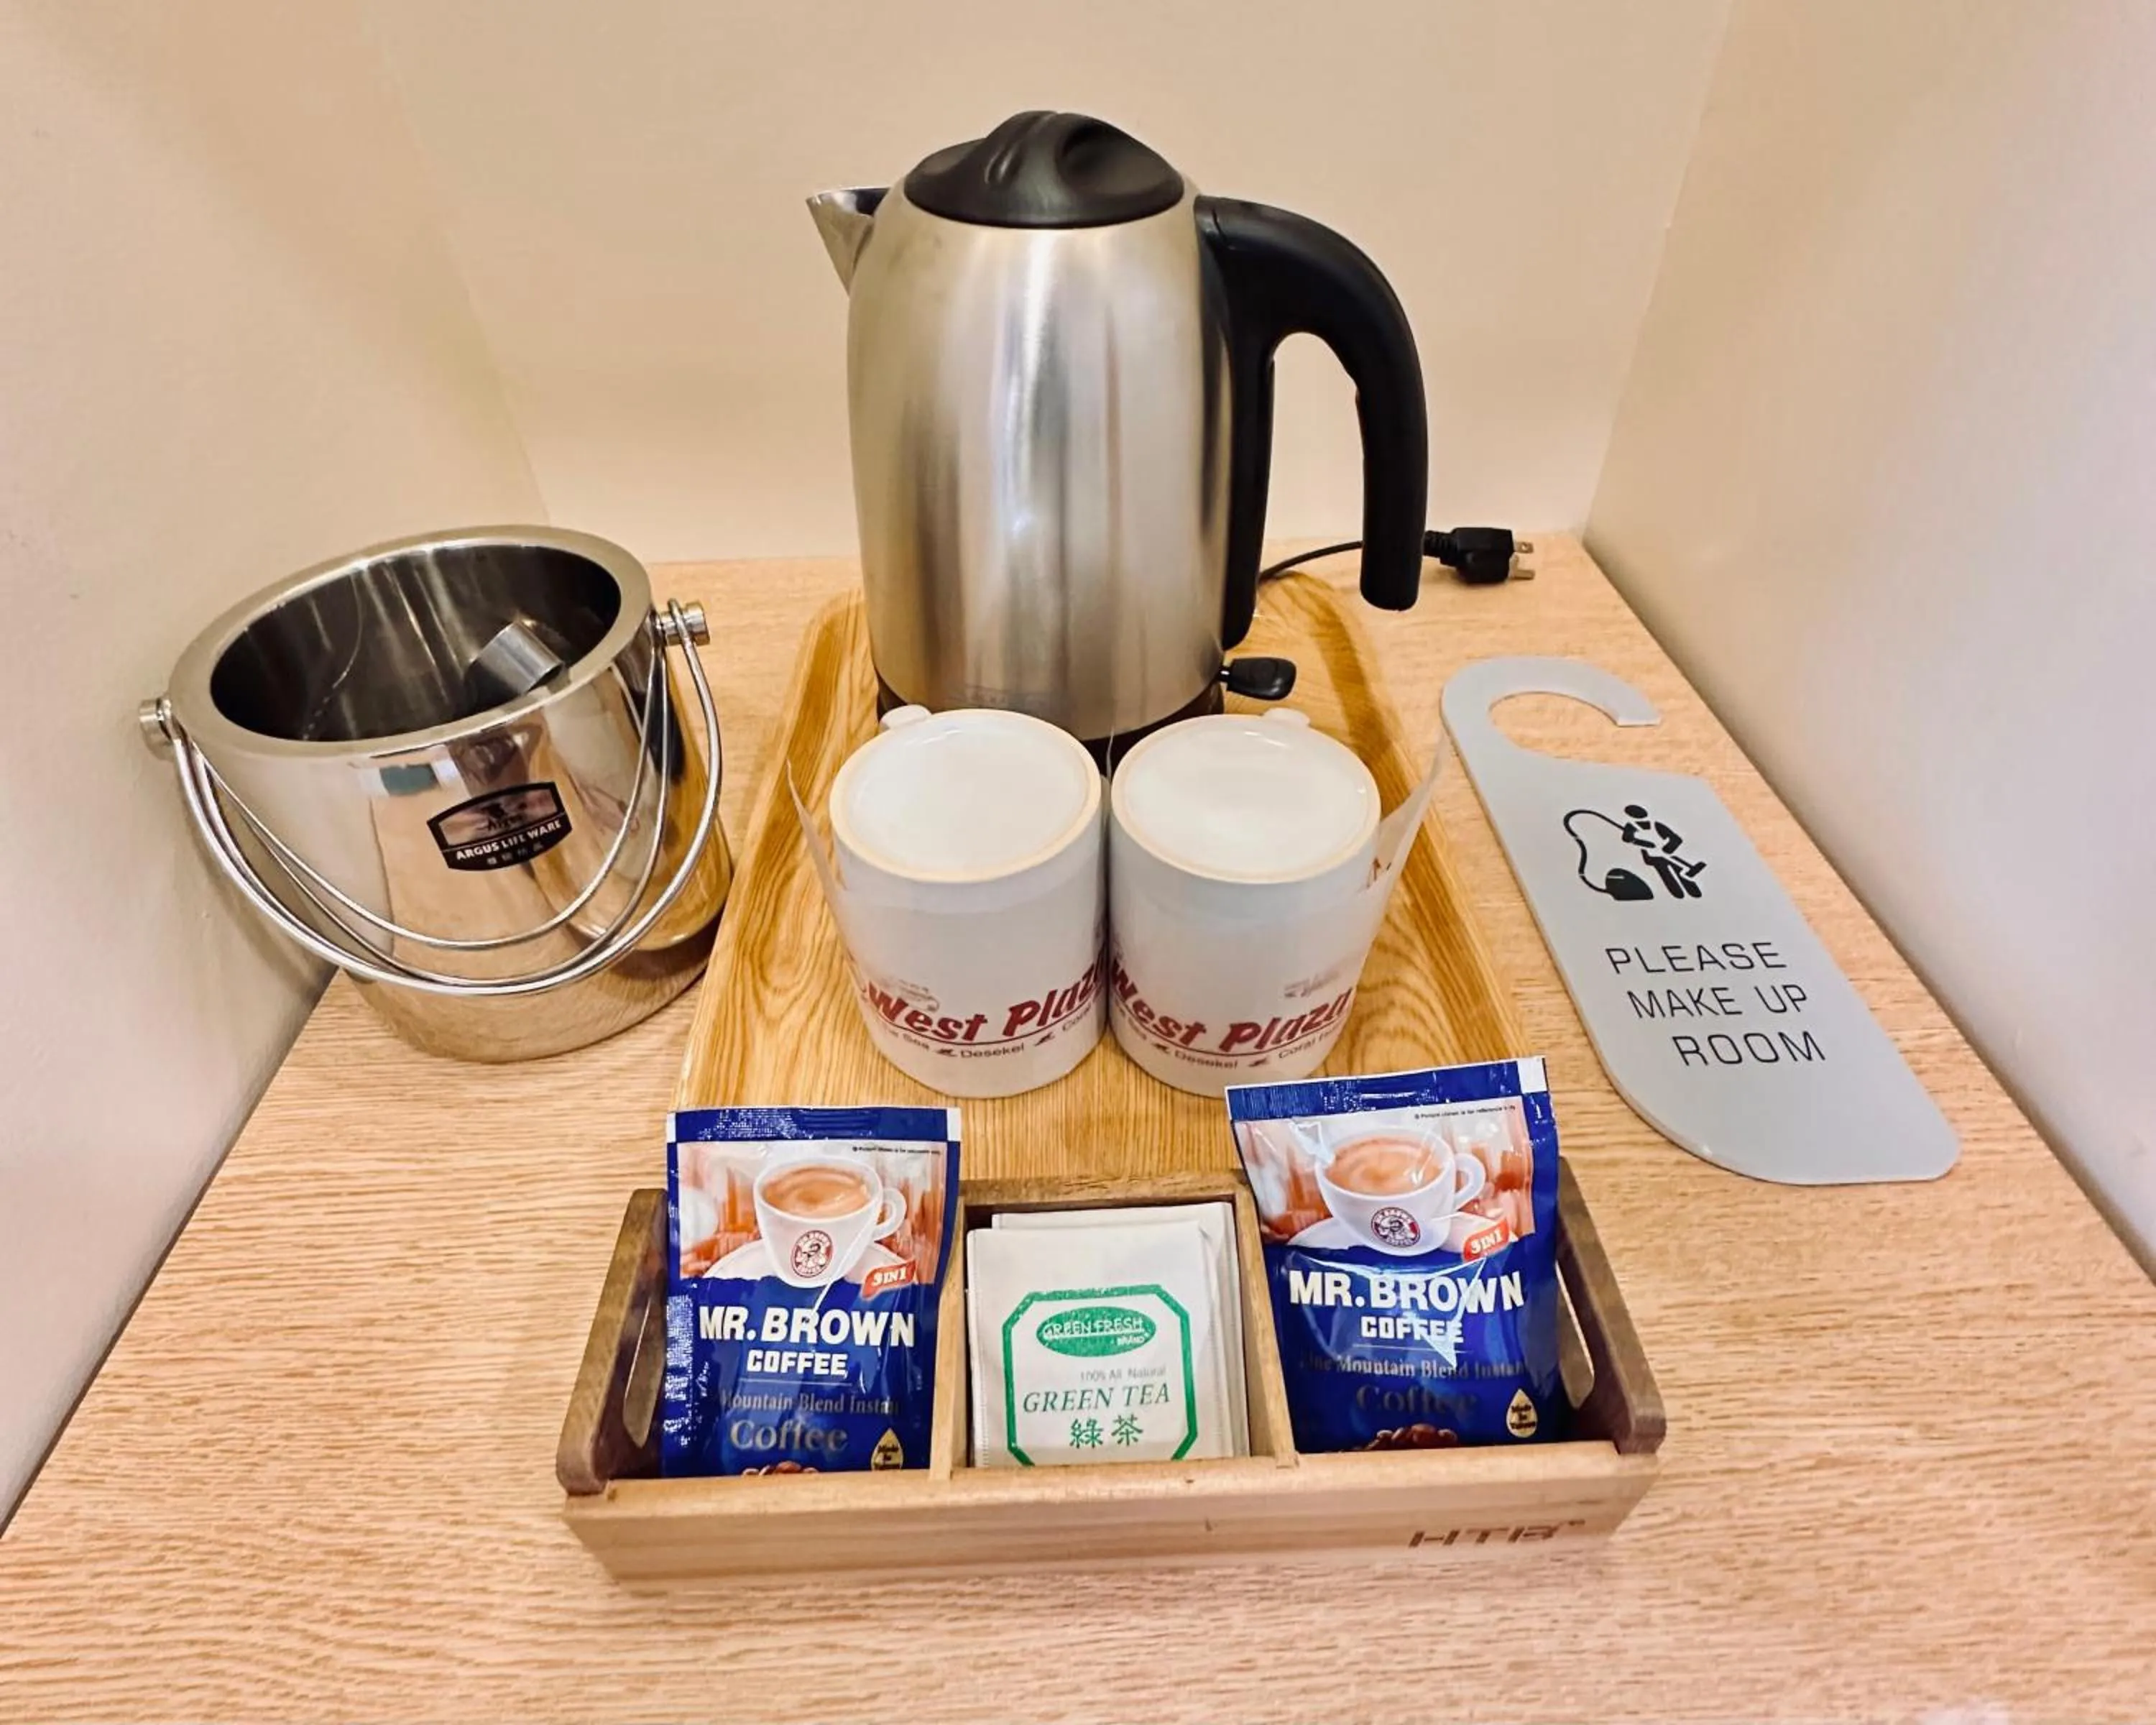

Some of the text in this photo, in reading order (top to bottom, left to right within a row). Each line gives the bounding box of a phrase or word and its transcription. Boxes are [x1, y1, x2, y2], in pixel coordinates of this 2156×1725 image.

[456, 841, 500, 860] ARGUS
[501, 834, 526, 848] LIFE
[527, 819, 562, 840] WARE
[1605, 942, 1787, 975] PLEASE
[867, 980, 989, 1041] West
[1626, 983, 1807, 1019] MAKE UP
[960, 1042, 1026, 1059] Desekel
[1672, 1030, 1826, 1067] ROOM
[872, 1266, 908, 1288] 3IN1
[1360, 1315, 1465, 1344] COFFEE
[746, 1348, 849, 1376] COFFEE
[1336, 1354, 1415, 1378] Mountain
[798, 1392, 844, 1413] Blend
[1023, 1382, 1171, 1414] GREEN TEA
[729, 1418, 849, 1452] Coffee
[1069, 1413, 1145, 1450] 綠茶
